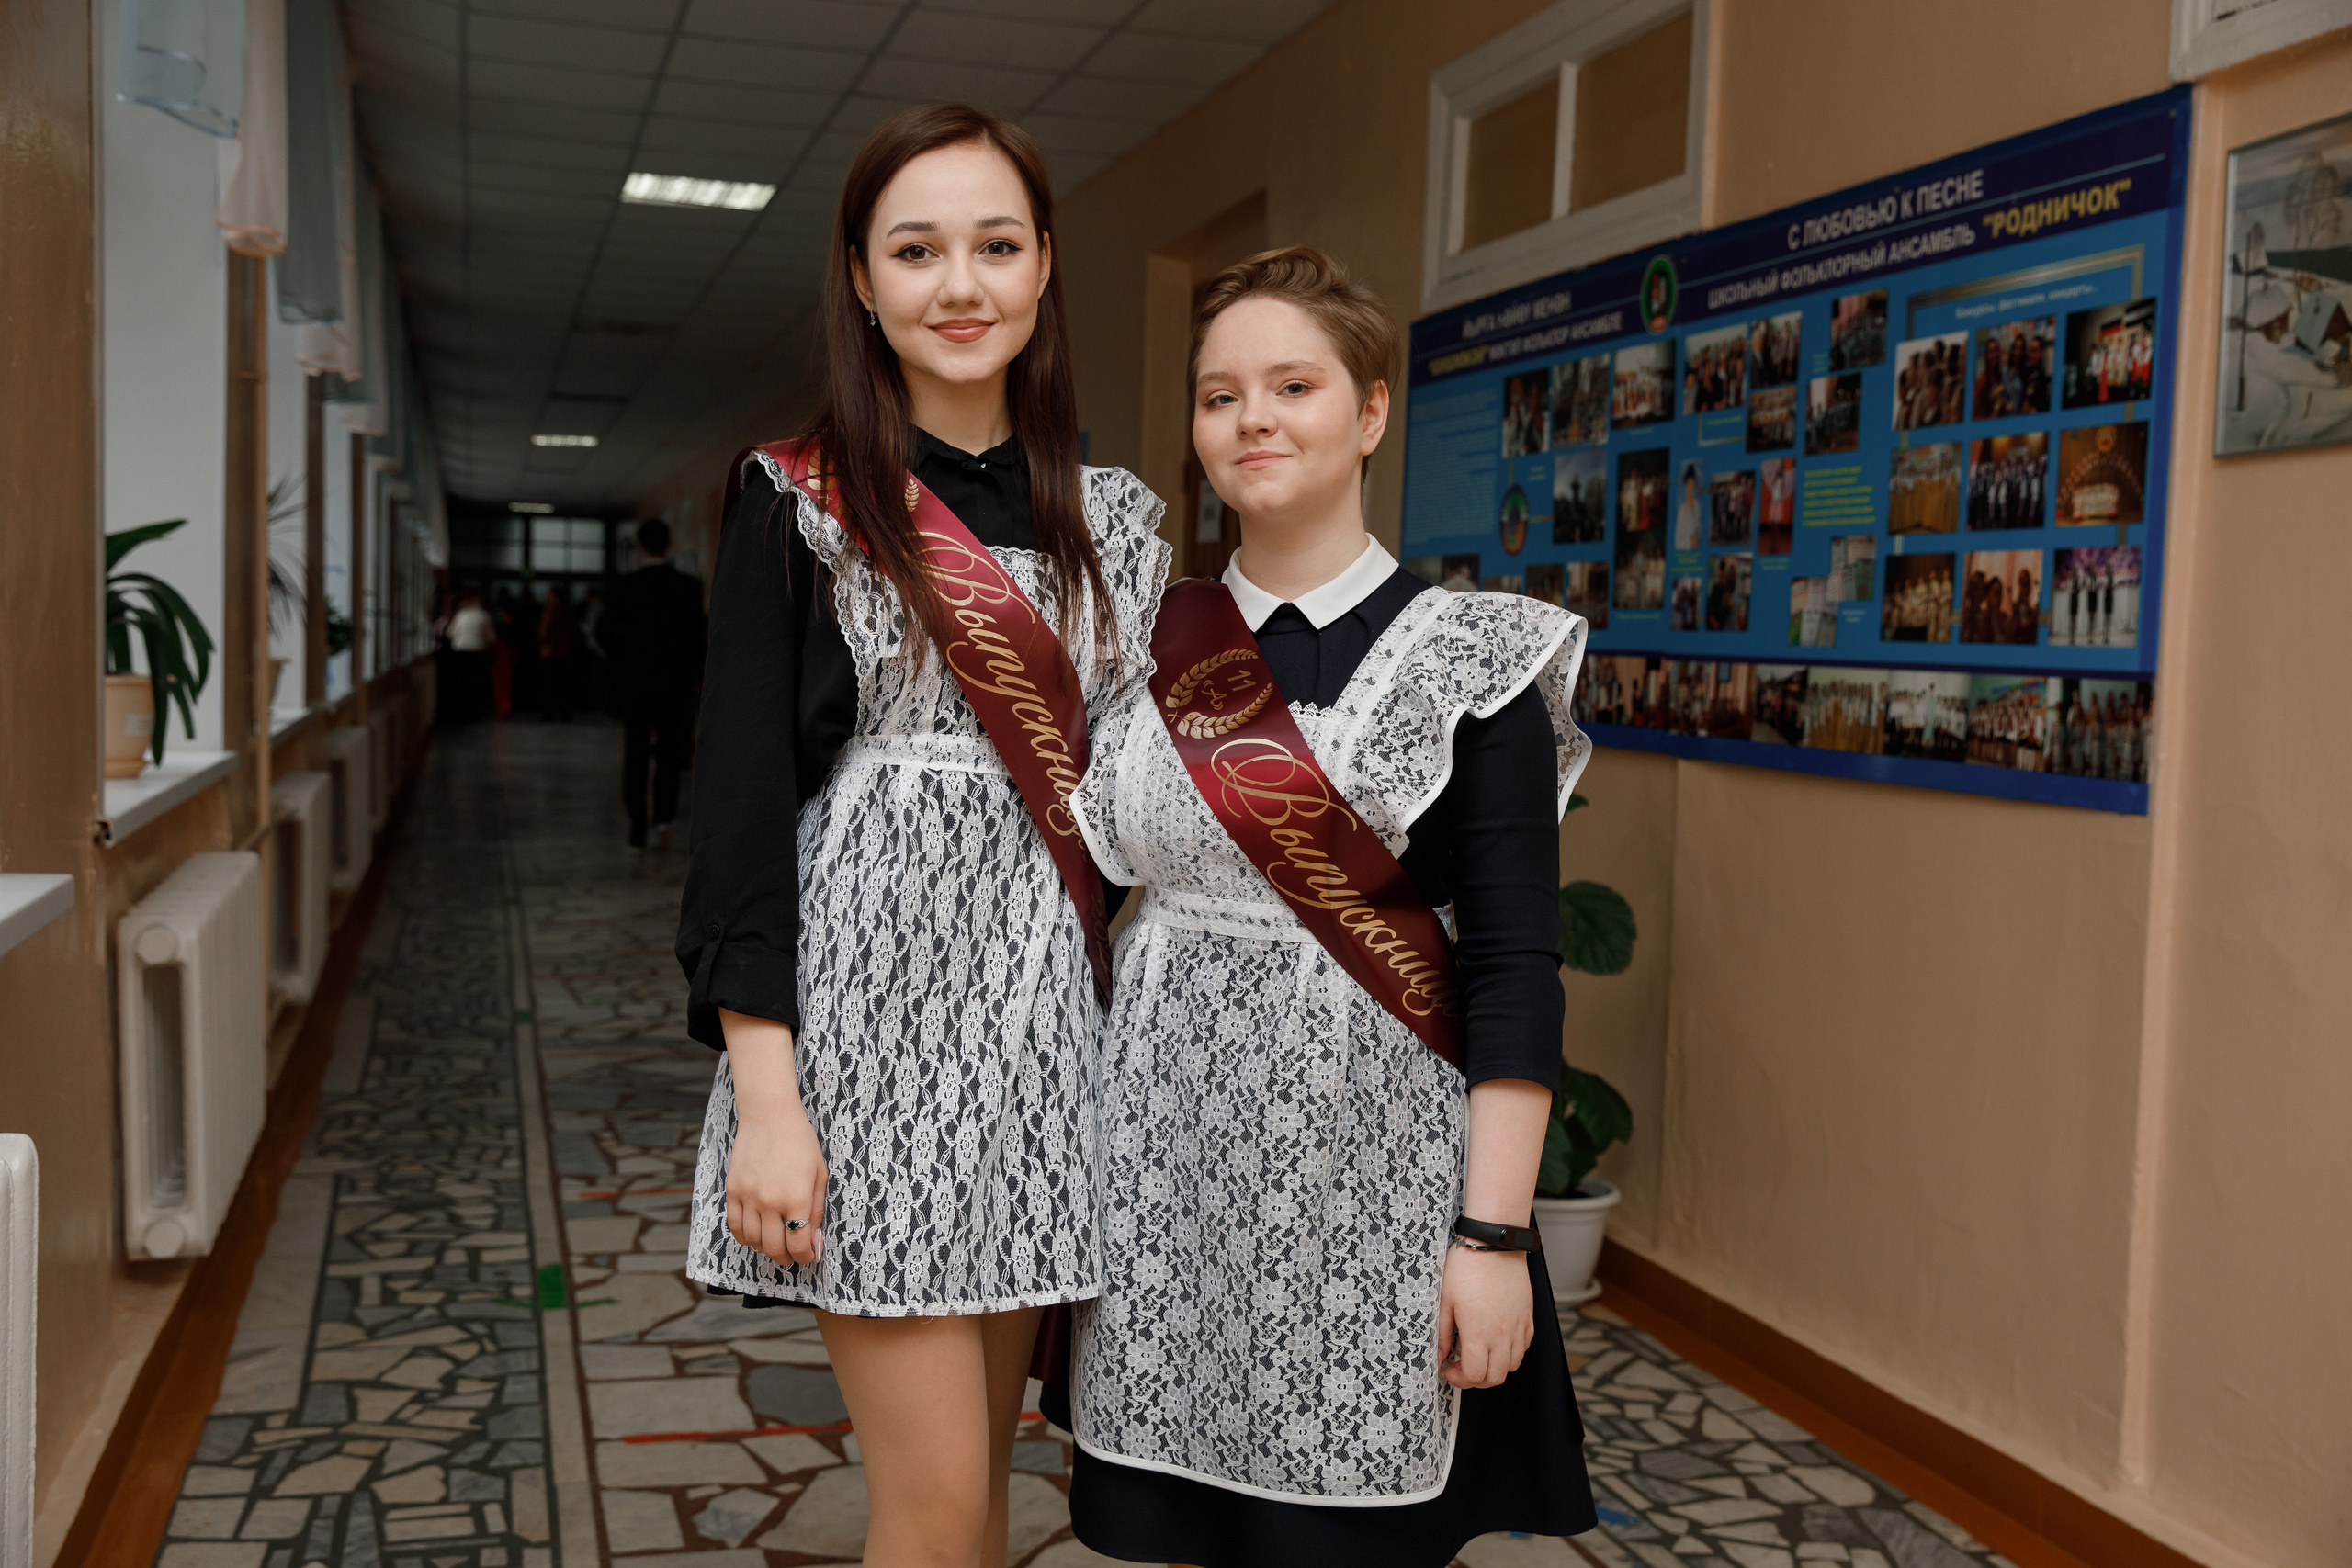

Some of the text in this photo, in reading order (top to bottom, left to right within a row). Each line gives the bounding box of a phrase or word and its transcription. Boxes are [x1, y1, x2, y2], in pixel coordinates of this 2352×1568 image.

[1802, 194, 1899, 246] ЛЮБОВЬЮ
[1901, 189, 1915, 219] К
[1917, 169, 1984, 215] ПЕСНЕ
[1707, 268, 1780, 310] ШКОЛЬНЫЙ
[1780, 241, 1888, 290] ФОЛЬКЛОРНЫЙ
[1887, 223, 1977, 265] АНСАМБЛЬ
[1227, 669, 1257, 692] 11
